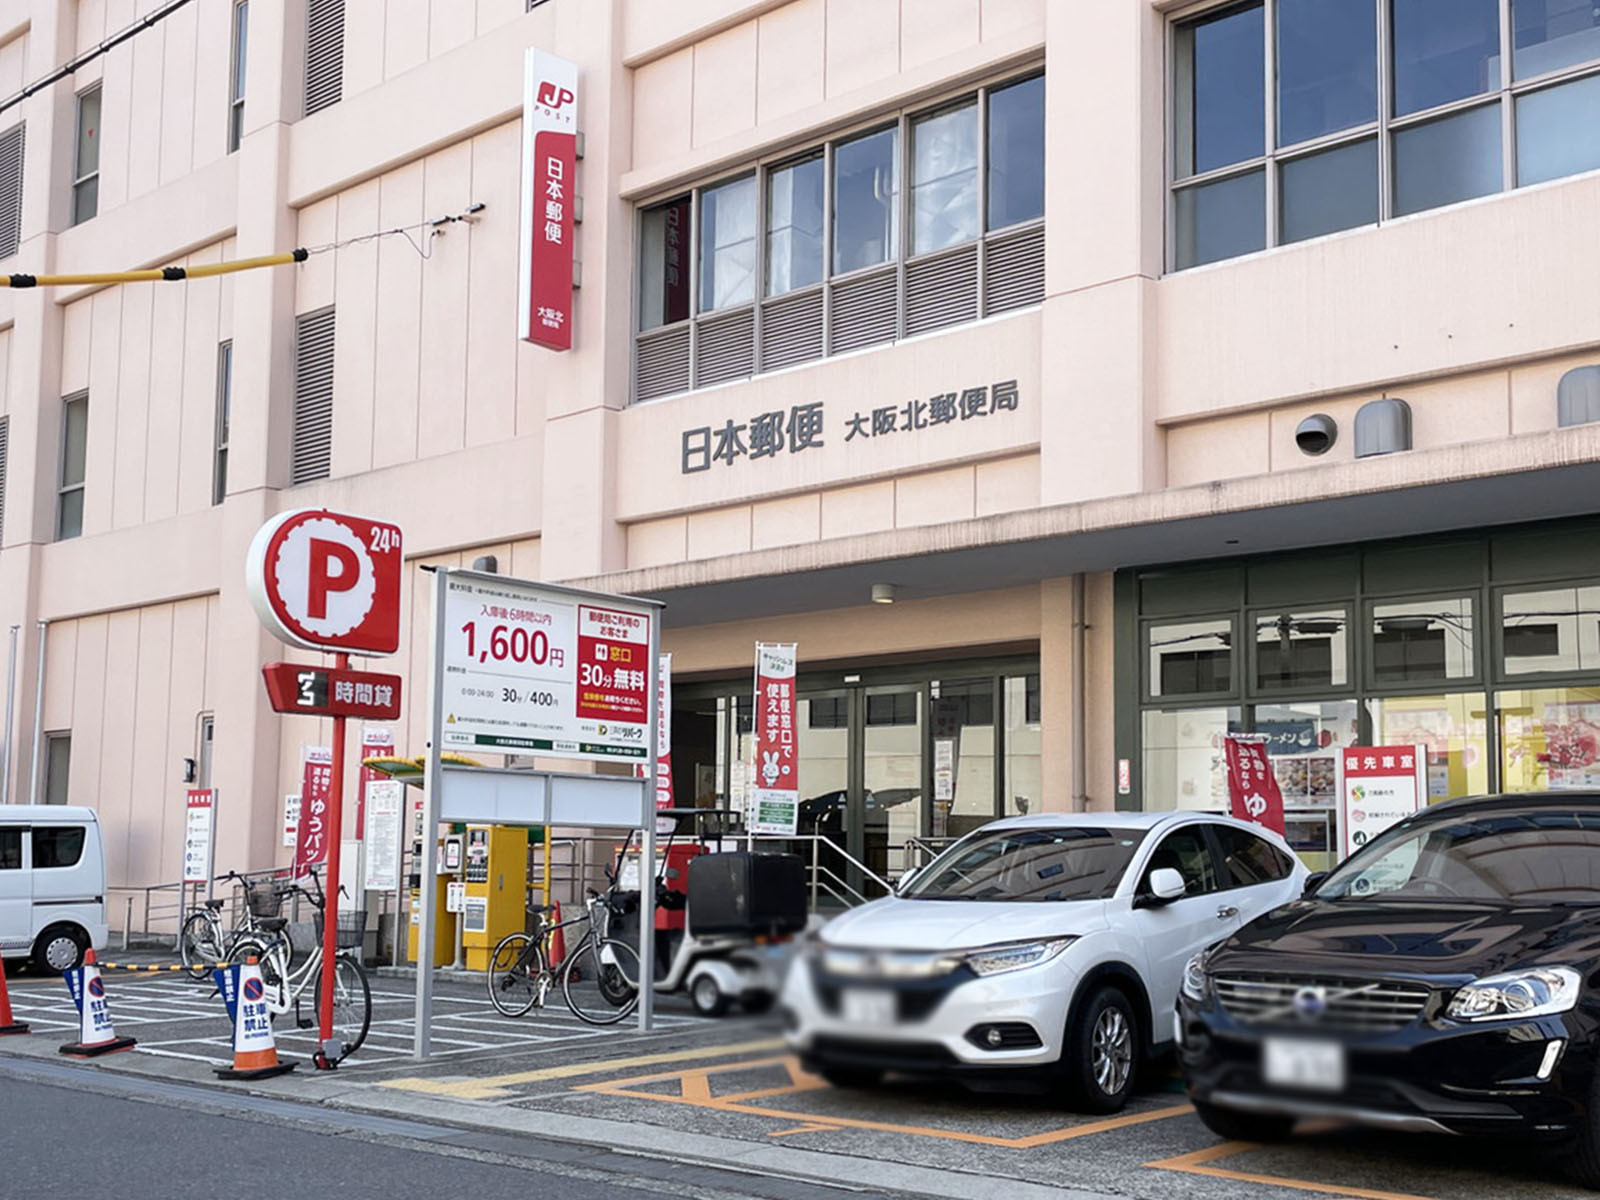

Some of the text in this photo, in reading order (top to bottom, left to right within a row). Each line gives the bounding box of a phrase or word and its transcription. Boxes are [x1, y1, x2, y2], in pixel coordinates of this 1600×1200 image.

[537, 81, 574, 109] JP
[534, 104, 571, 123] POST
[544, 156, 563, 244] 日本郵便
[537, 306, 564, 323] 大阪北
[682, 379, 1019, 475] 日本郵便 大阪北郵便局
[370, 526, 400, 553] 24h
[307, 537, 360, 620] P
[461, 620, 565, 668] 1,600円
[600, 625, 628, 639] お客さま
[609, 646, 632, 663] 窓口
[335, 681, 393, 708] 時間貸
[766, 683, 780, 743] 使えます
[780, 683, 793, 758] 郵便窓口で
[1345, 754, 1414, 771] 優先車室
[1243, 792, 1267, 828] ゆ
[243, 1003, 267, 1017] 駐車
[244, 1017, 269, 1032] 禁止
